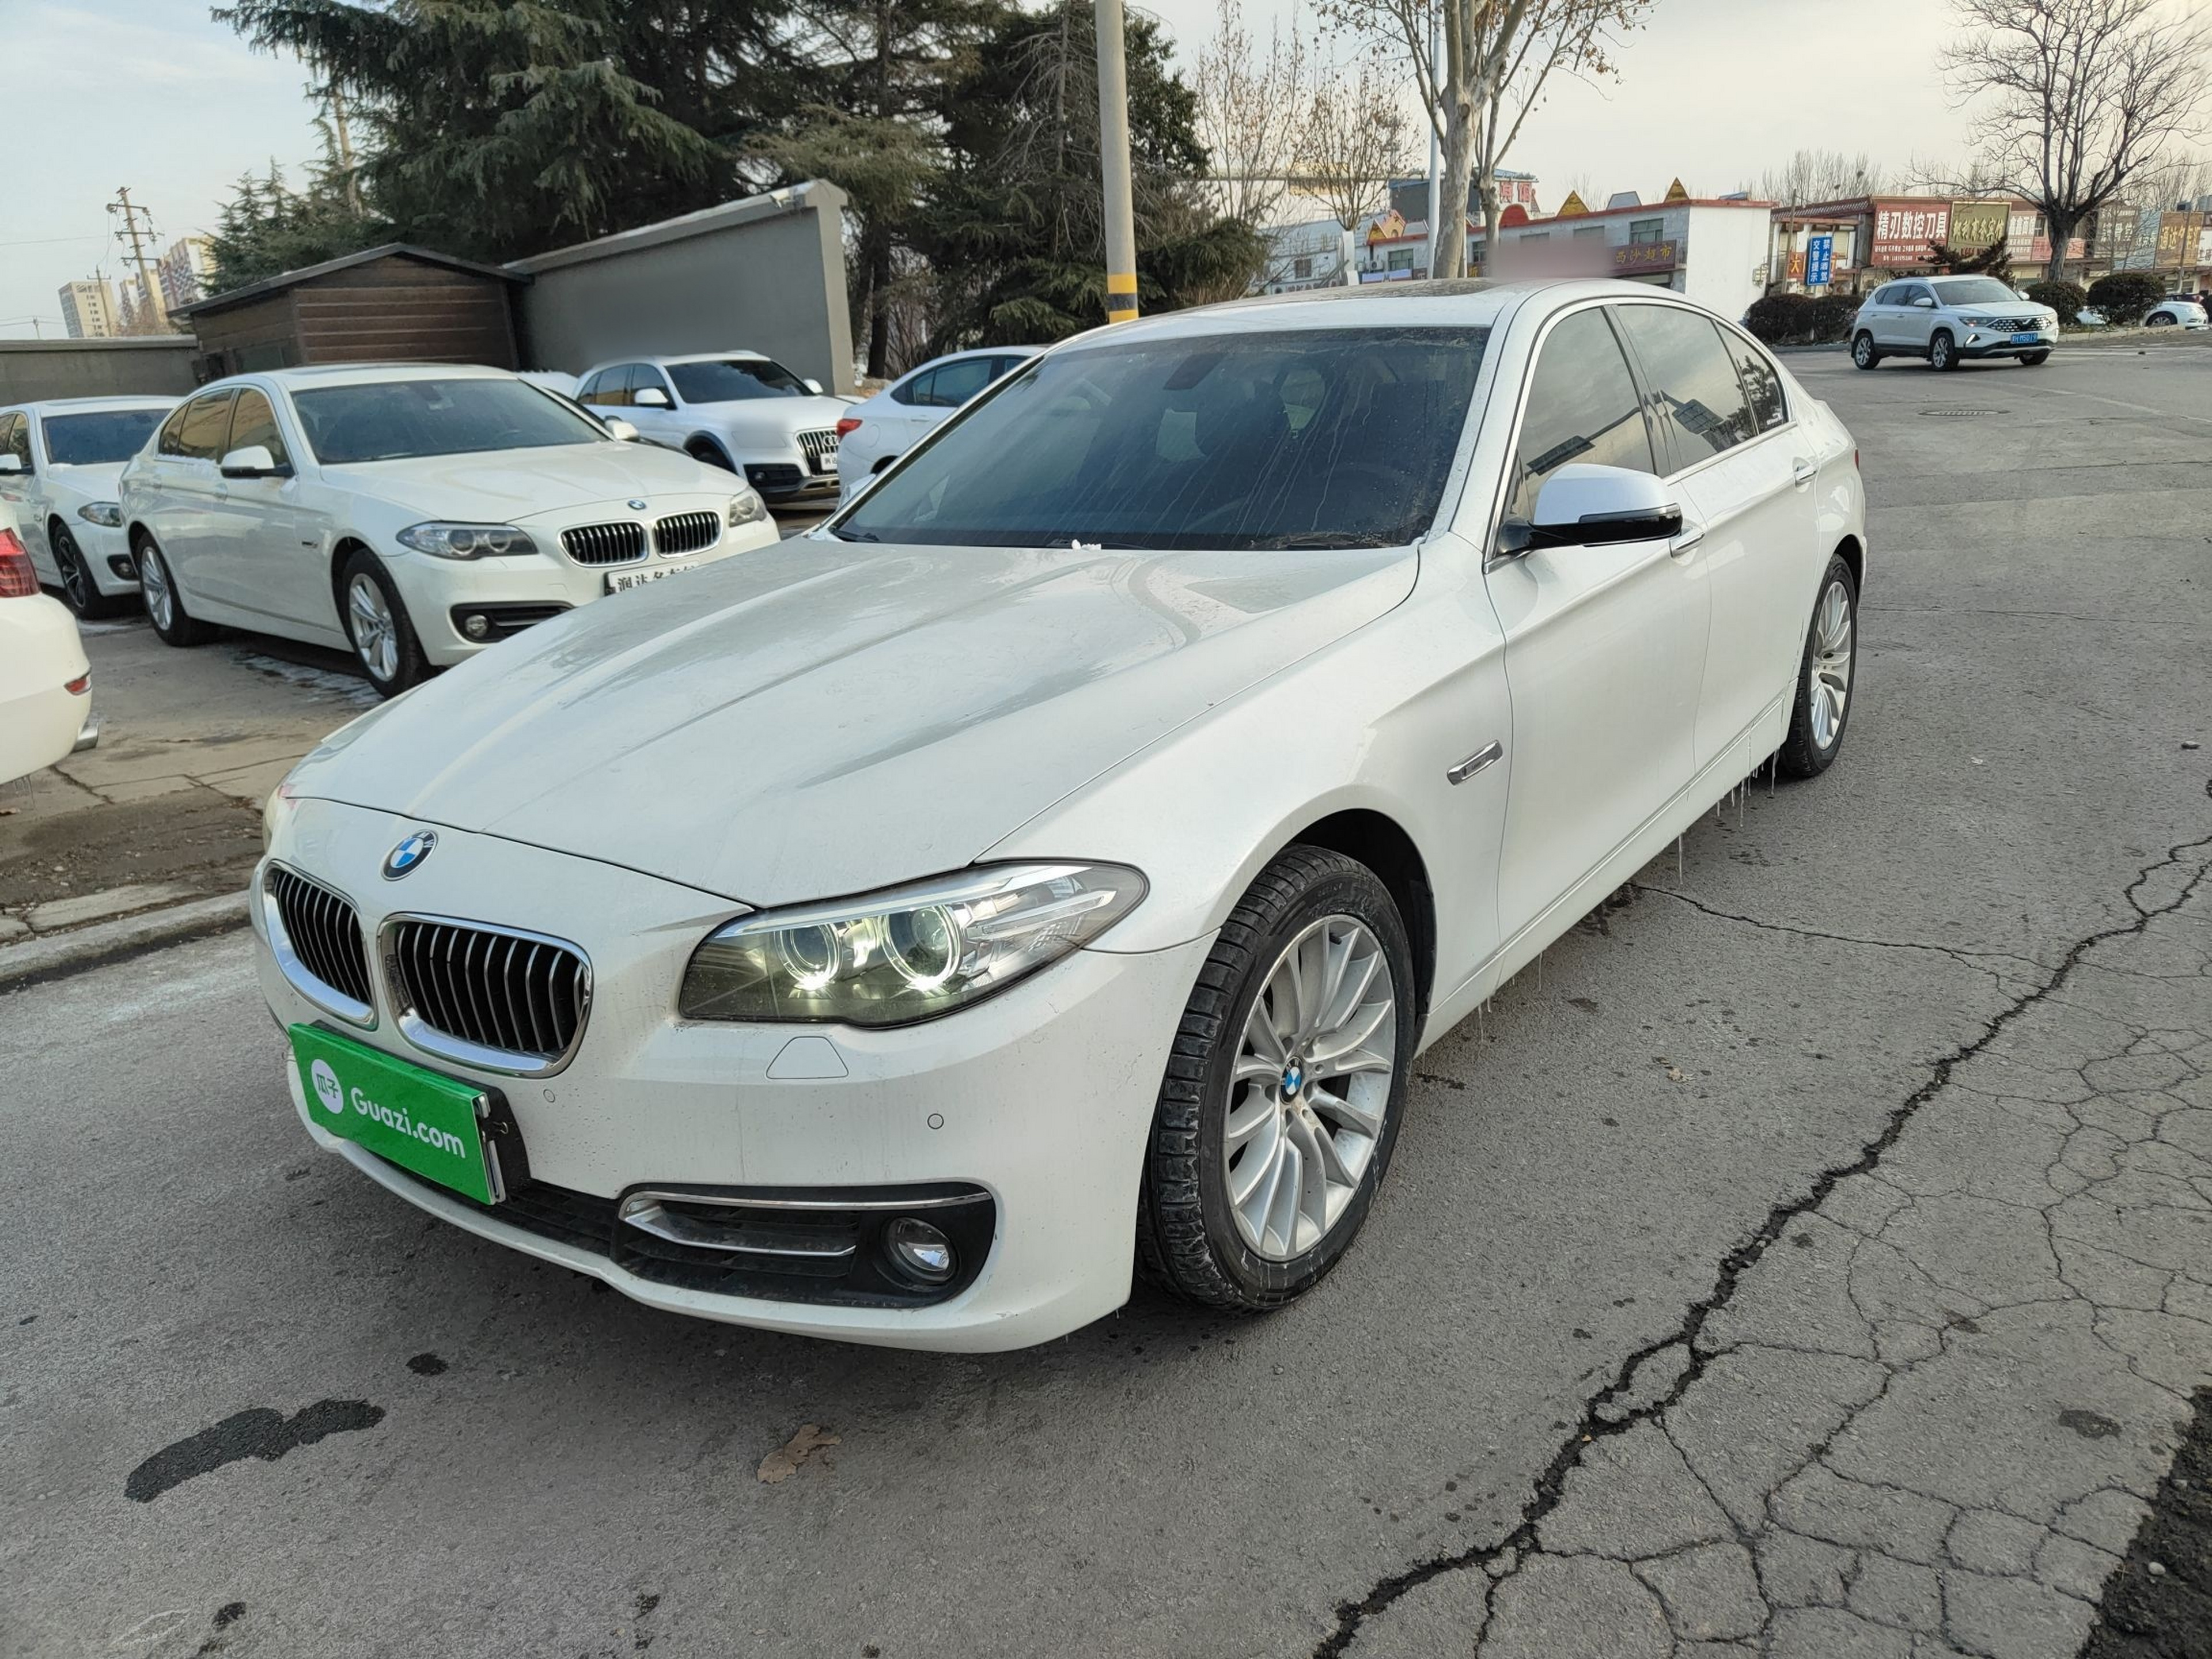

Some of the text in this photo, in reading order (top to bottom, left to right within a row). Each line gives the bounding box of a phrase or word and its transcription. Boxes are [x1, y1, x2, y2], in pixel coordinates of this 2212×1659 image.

[1877, 210, 1947, 240] 精刃数控刀具
[1810, 240, 1820, 282] 交警提示
[1820, 239, 1830, 281] 禁止酒驾
[316, 1073, 339, 1099] 瓜子
[350, 1087, 466, 1159] Guazi.com
